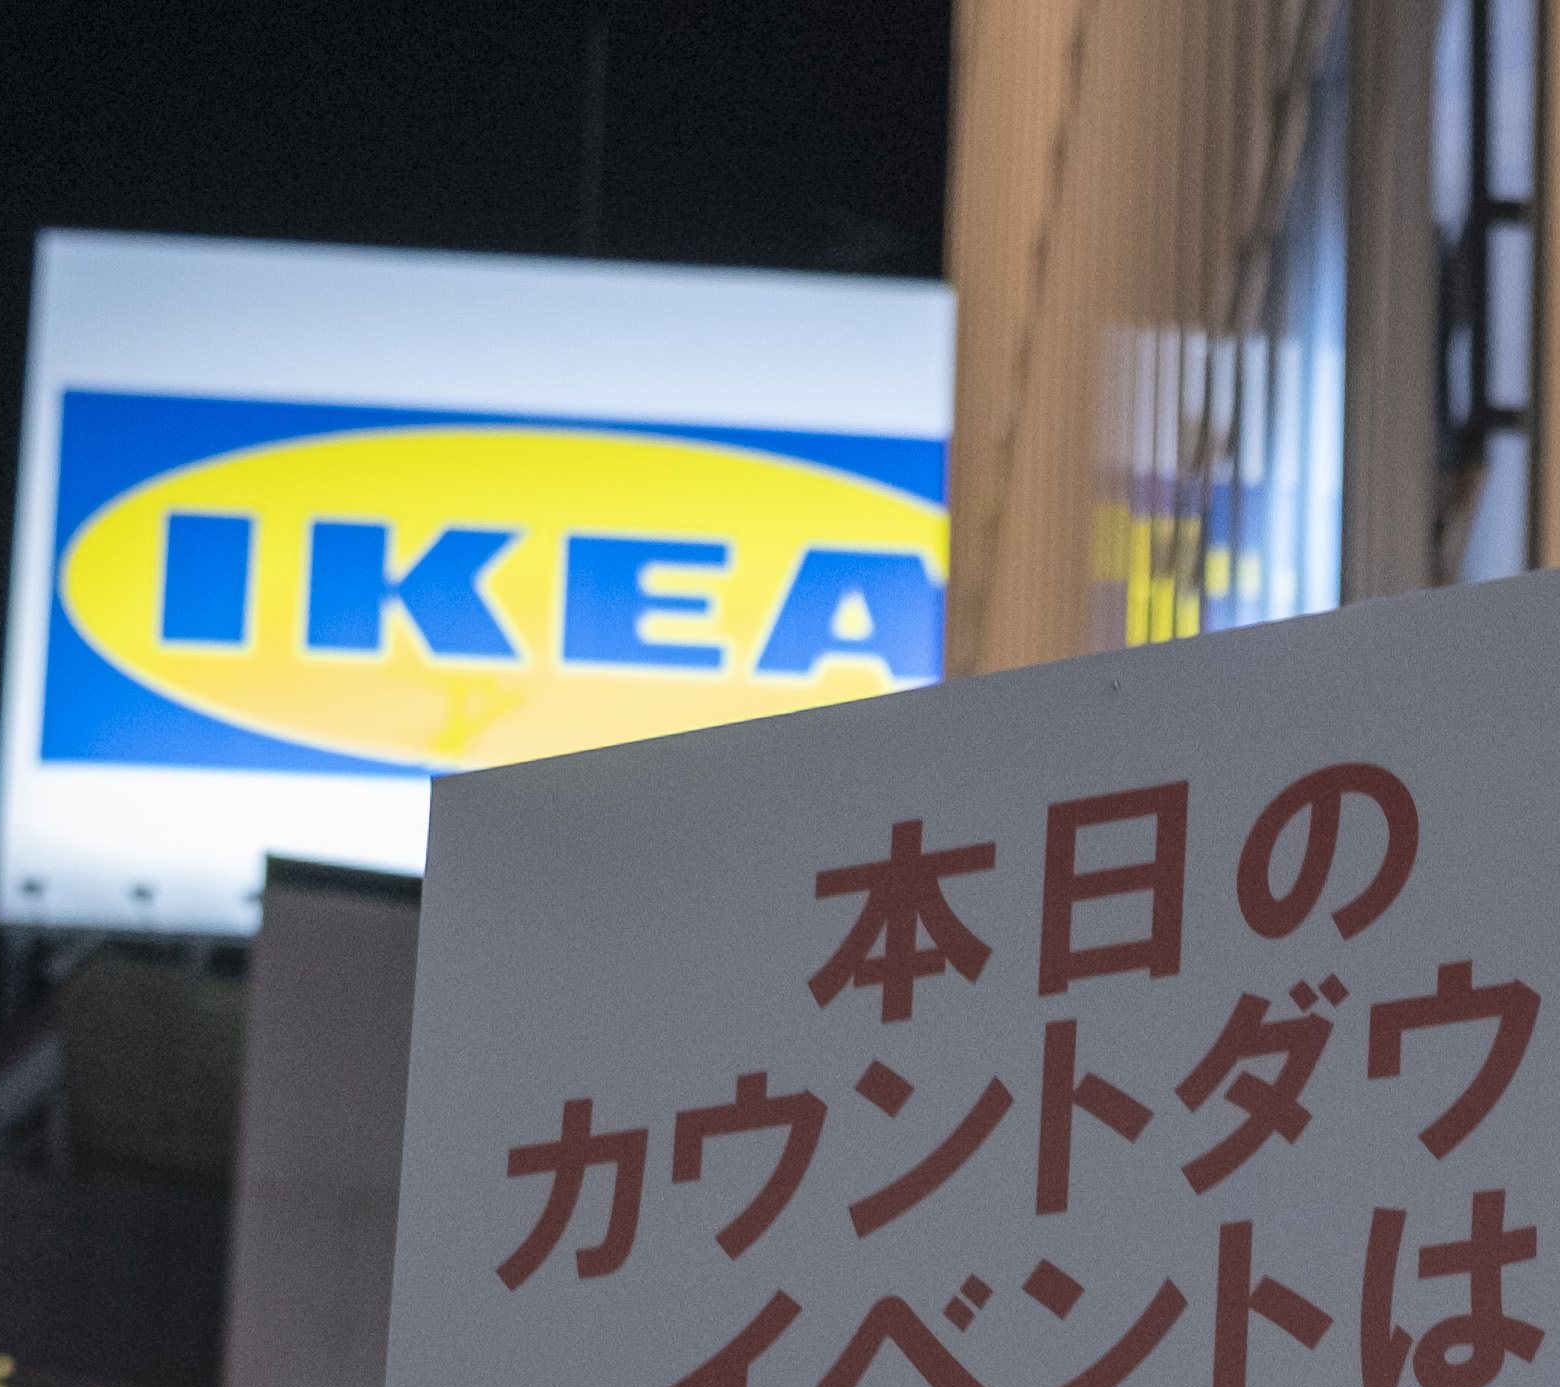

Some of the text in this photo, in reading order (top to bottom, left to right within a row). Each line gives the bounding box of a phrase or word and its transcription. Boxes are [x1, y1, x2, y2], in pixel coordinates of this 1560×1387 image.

[157, 509, 944, 685] IKEA
[808, 760, 1420, 1024] 本日の
